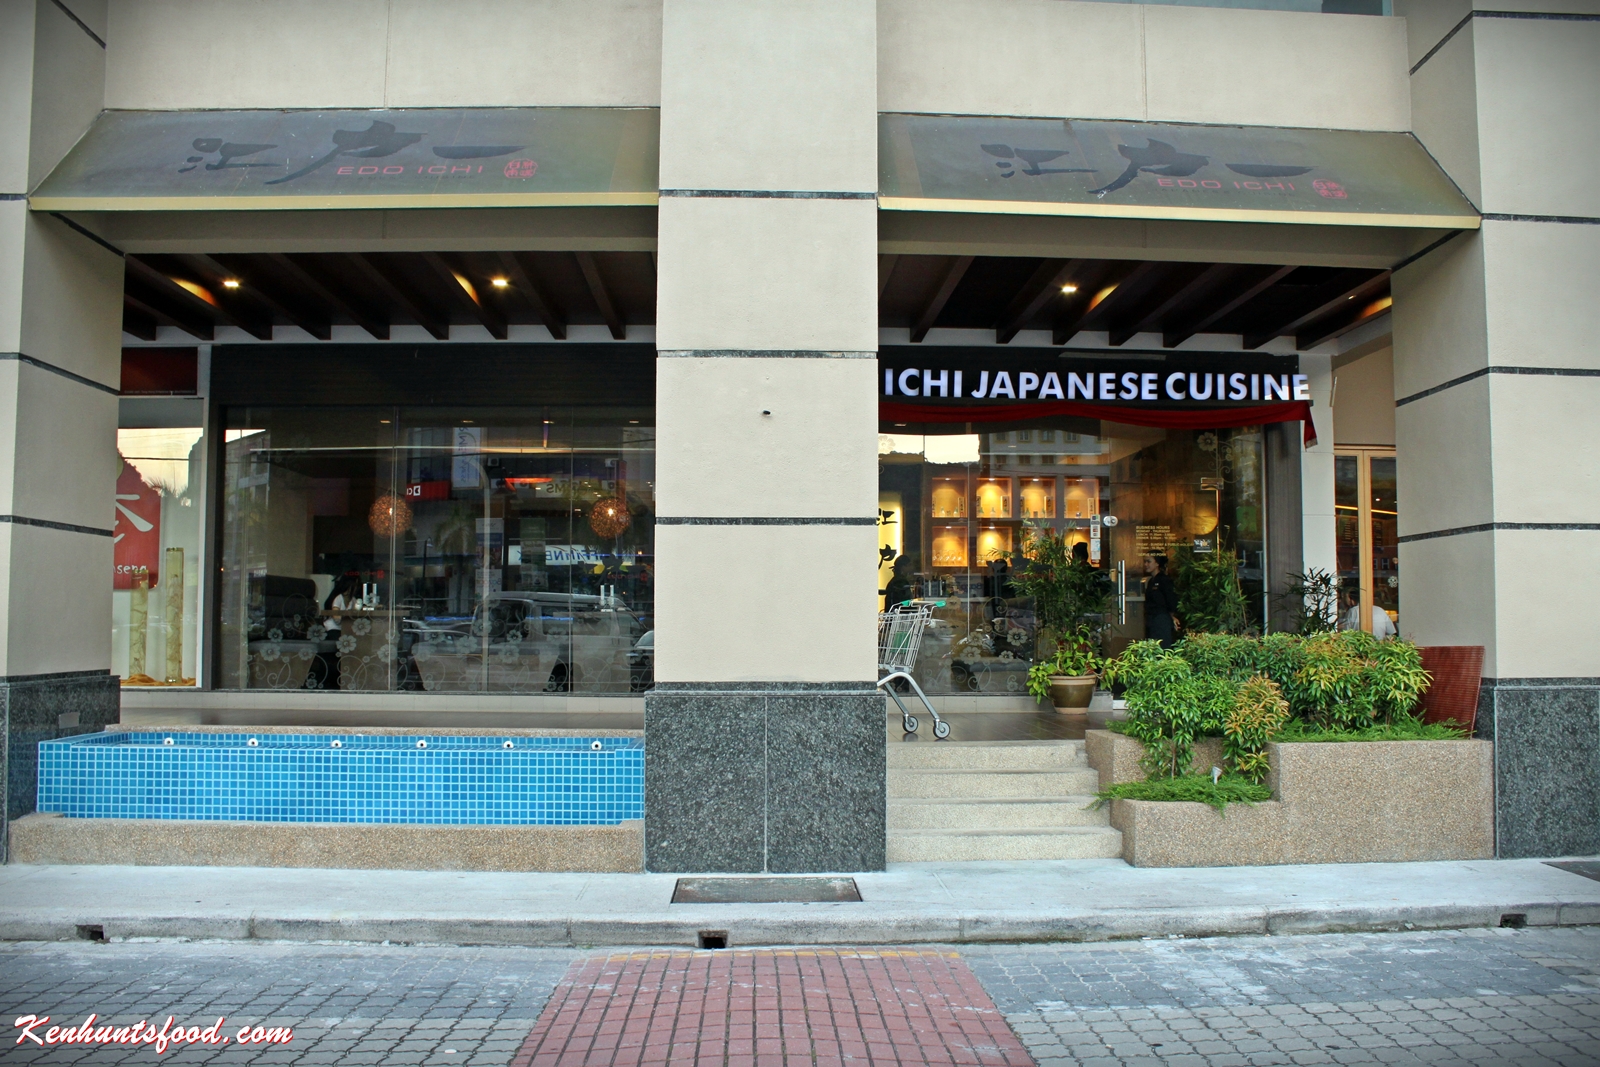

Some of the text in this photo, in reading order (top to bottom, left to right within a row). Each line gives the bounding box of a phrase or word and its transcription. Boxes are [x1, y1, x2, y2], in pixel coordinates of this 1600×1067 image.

[337, 165, 484, 174] EDO ICHI
[1157, 178, 1296, 191] EDO ICHI
[885, 368, 1310, 400] ICHI JAPANESE CUISINE
